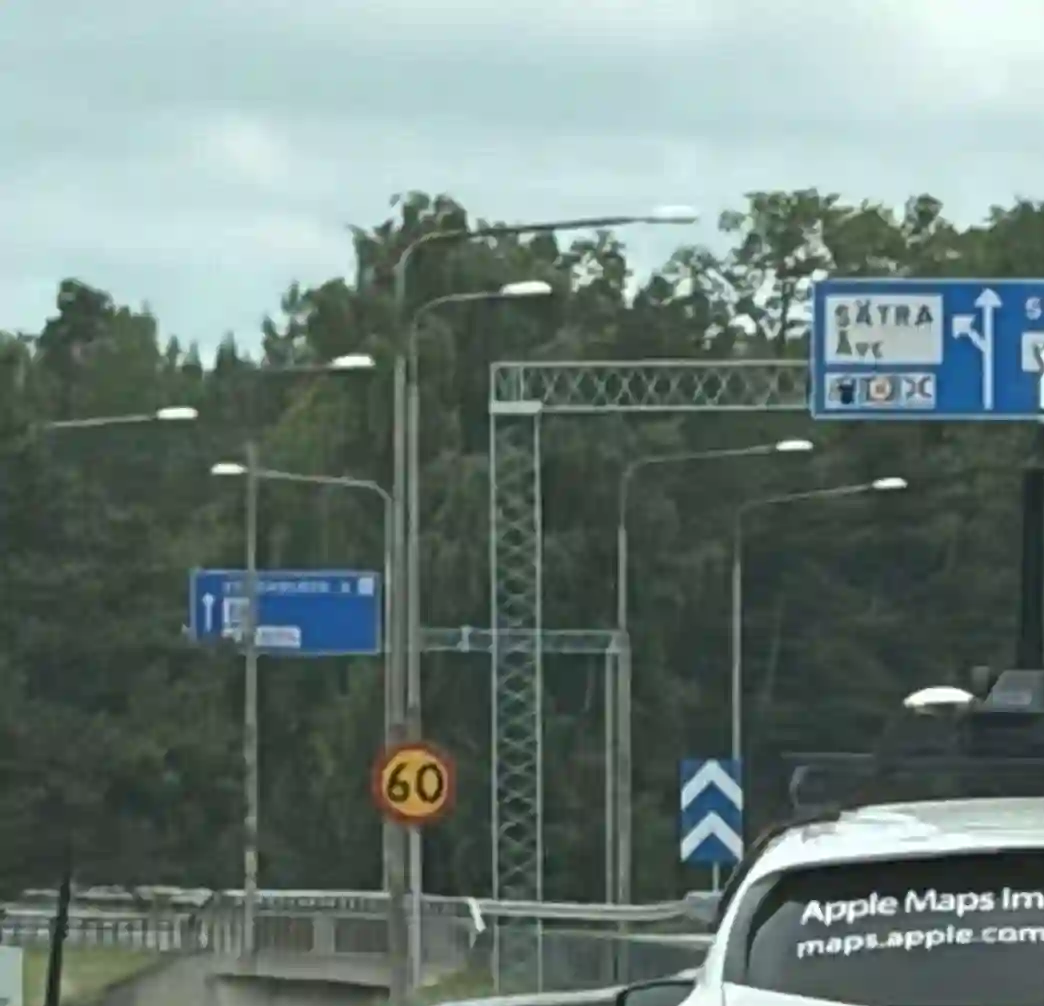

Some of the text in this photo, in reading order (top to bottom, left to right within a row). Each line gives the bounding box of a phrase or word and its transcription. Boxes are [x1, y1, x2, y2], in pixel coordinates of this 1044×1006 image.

[835, 299, 934, 328] SÄTRA
[387, 761, 443, 804] 60
[801, 891, 899, 927] Apple
[904, 887, 995, 918] Maps
